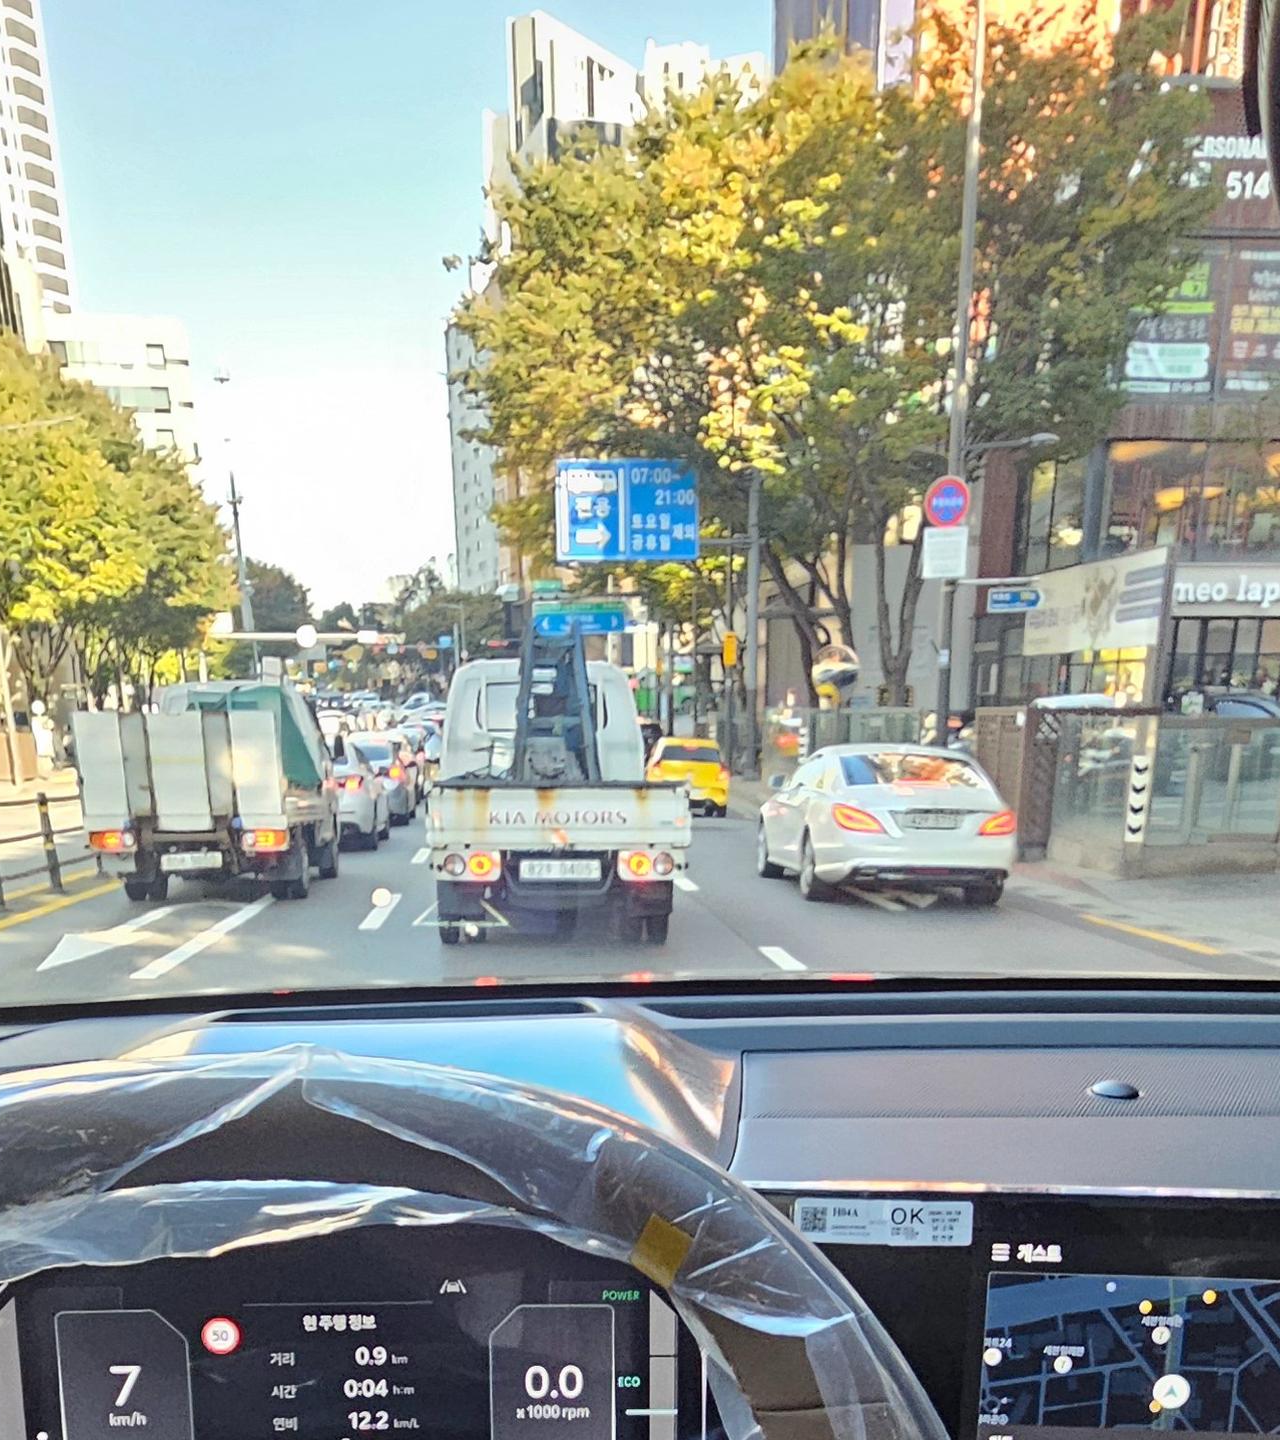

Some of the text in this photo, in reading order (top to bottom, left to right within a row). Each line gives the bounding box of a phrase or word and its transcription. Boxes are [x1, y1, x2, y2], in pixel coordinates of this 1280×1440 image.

[655, 489, 695, 506] 21:00
[489, 810, 628, 825] KIA MOTORS
[891, 1207, 924, 1225] OK
[602, 1290, 640, 1300] POWER
[212, 1330, 229, 1341] 50
[270, 1346, 408, 1366] 거리 0.9 km
[109, 1366, 141, 1407] 7
[271, 1379, 415, 1399] 시간 0:04 h:m
[524, 1365, 584, 1399] 0.0
[617, 1376, 641, 1387] ECO
[109, 1412, 147, 1427] km/h
[272, 1411, 419, 1431] 연비 12.2 km/L
